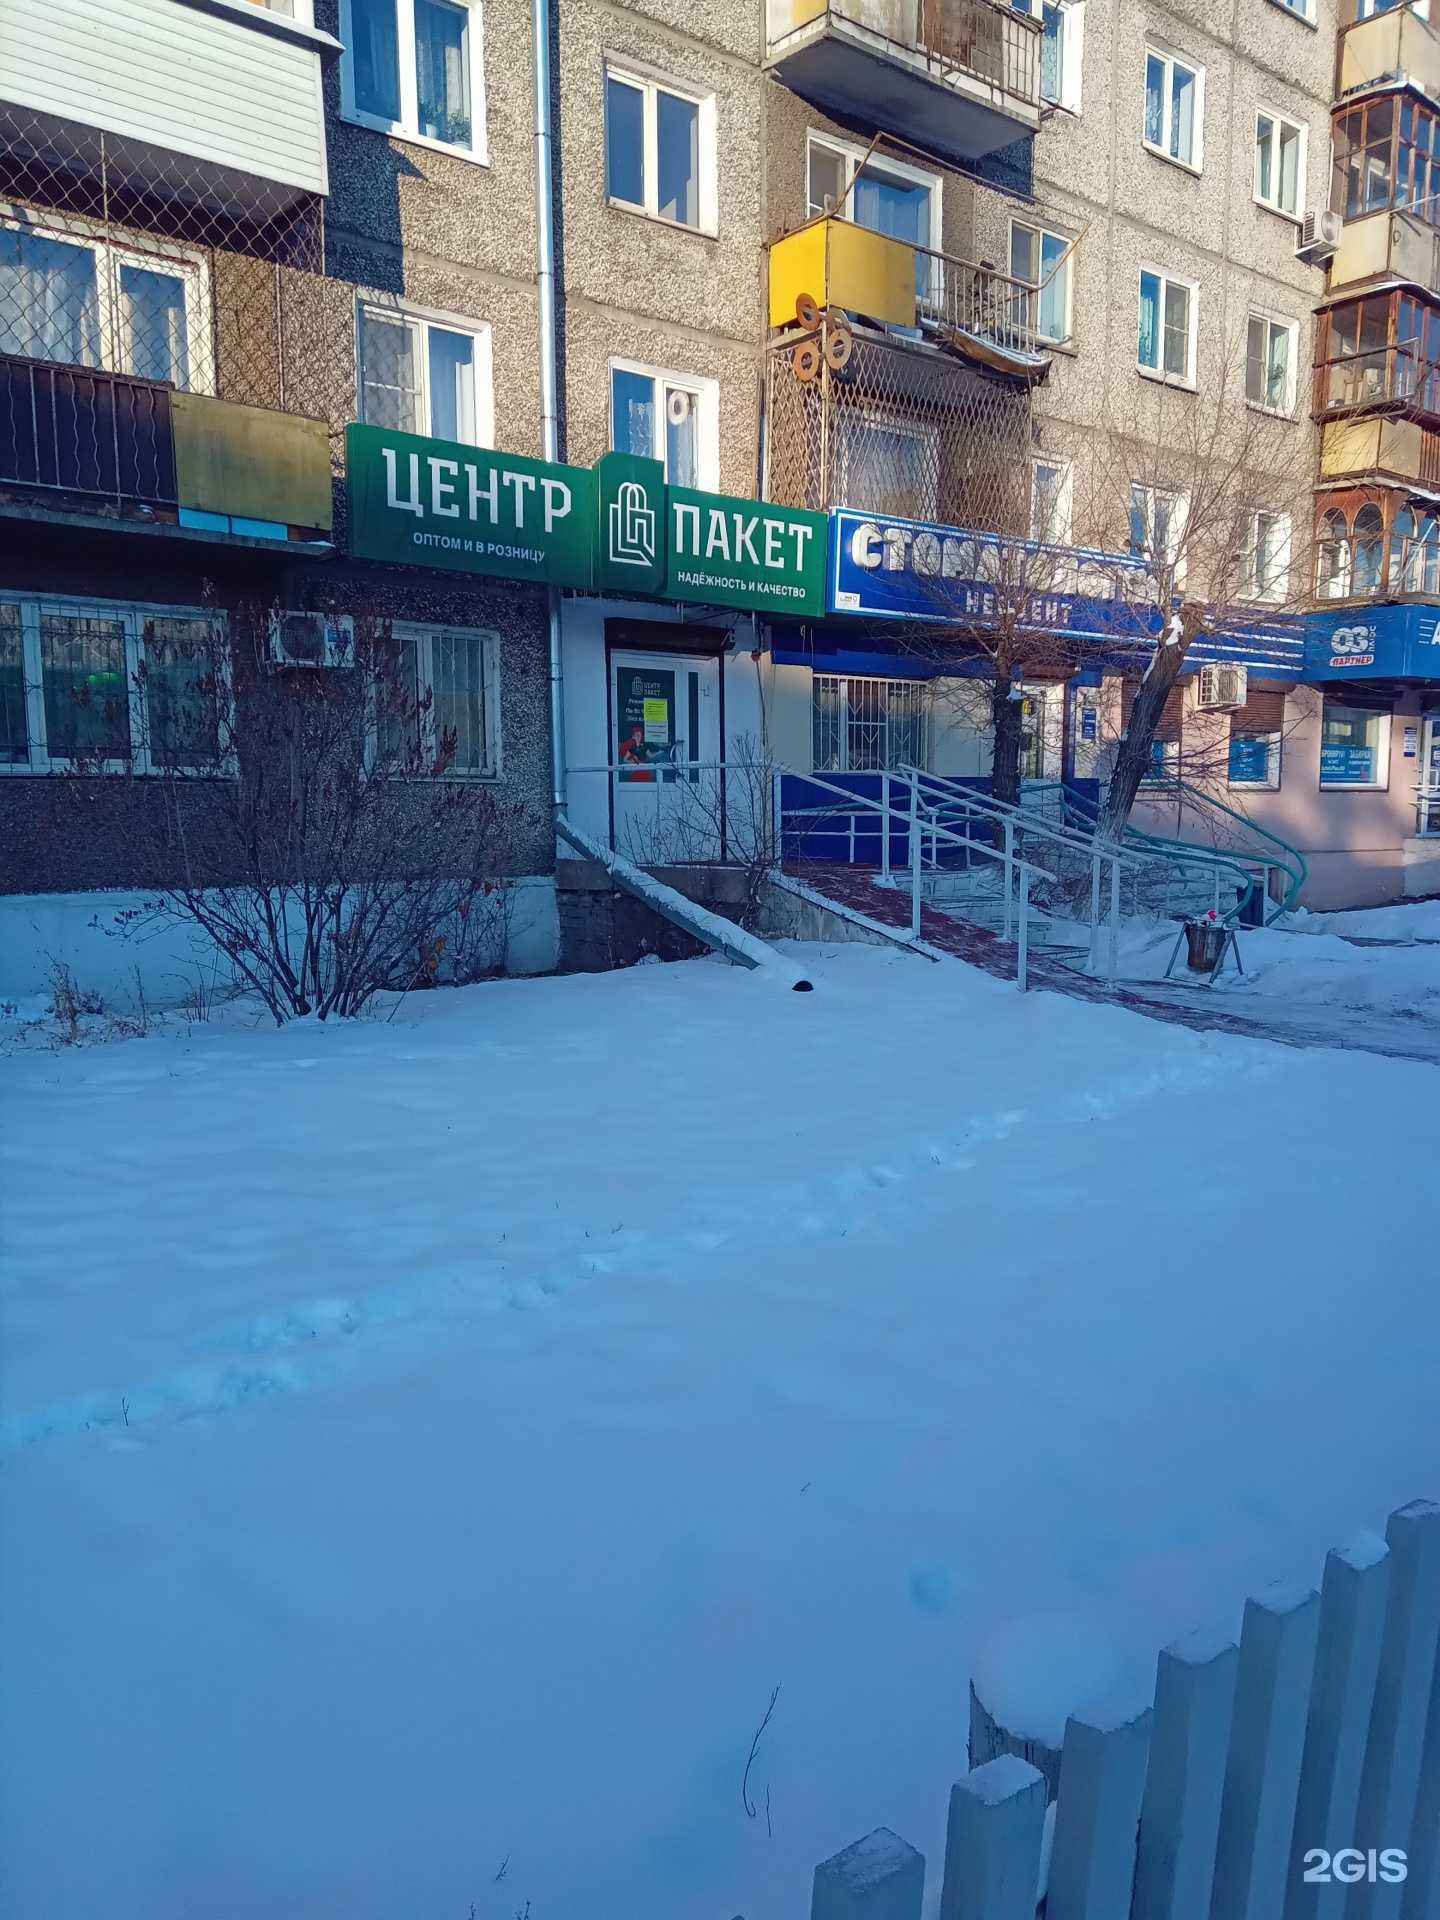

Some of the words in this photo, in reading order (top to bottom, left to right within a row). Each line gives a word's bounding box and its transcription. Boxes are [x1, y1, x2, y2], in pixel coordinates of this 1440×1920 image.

[382, 448, 572, 533] ЦЕНТР
[413, 532, 462, 550] ОПТОМ
[464, 540, 474, 551] И
[476, 542, 485, 553] В
[488, 543, 545, 563] РОЗНИЦУ
[672, 502, 813, 572] ПАКЕТ
[678, 570, 747, 591] НАДЁЖНОСТЬ
[749, 581, 755, 591] И
[757, 582, 806, 598] КАЧЕСТВО
[1332, 656, 1373, 666] ПАРТНЕР
